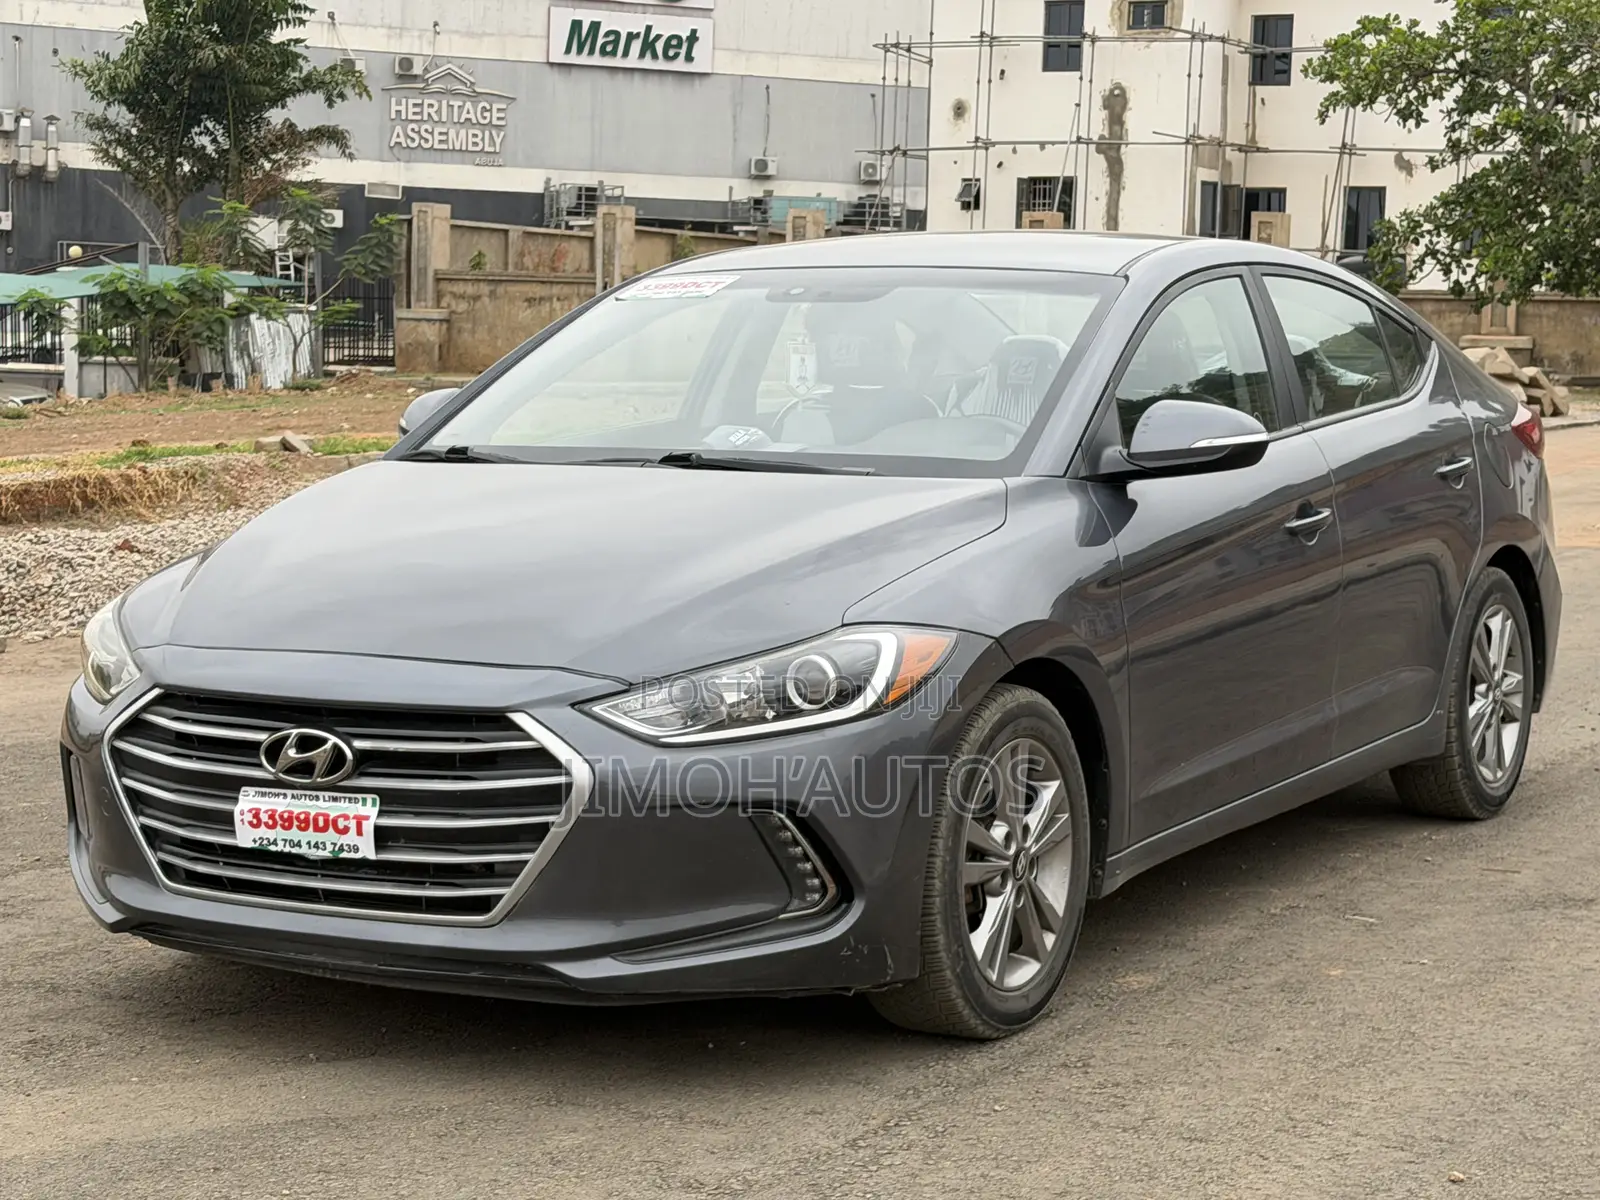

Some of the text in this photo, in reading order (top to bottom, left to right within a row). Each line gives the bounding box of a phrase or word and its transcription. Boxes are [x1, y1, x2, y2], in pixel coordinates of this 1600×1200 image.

[563, 19, 699, 63] Market
[390, 97, 507, 126] HERITAGE
[389, 123, 505, 153] ASSEMBLY
[474, 157, 504, 166] ABUJA
[252, 791, 360, 804] JIMOH'S AUTOS LIMITED
[246, 807, 371, 837] 3399DCT
[252, 837, 278, 847] +234
[282, 838, 302, 849] 704
[306, 840, 327, 851] 143
[330, 842, 360, 854] 7439
